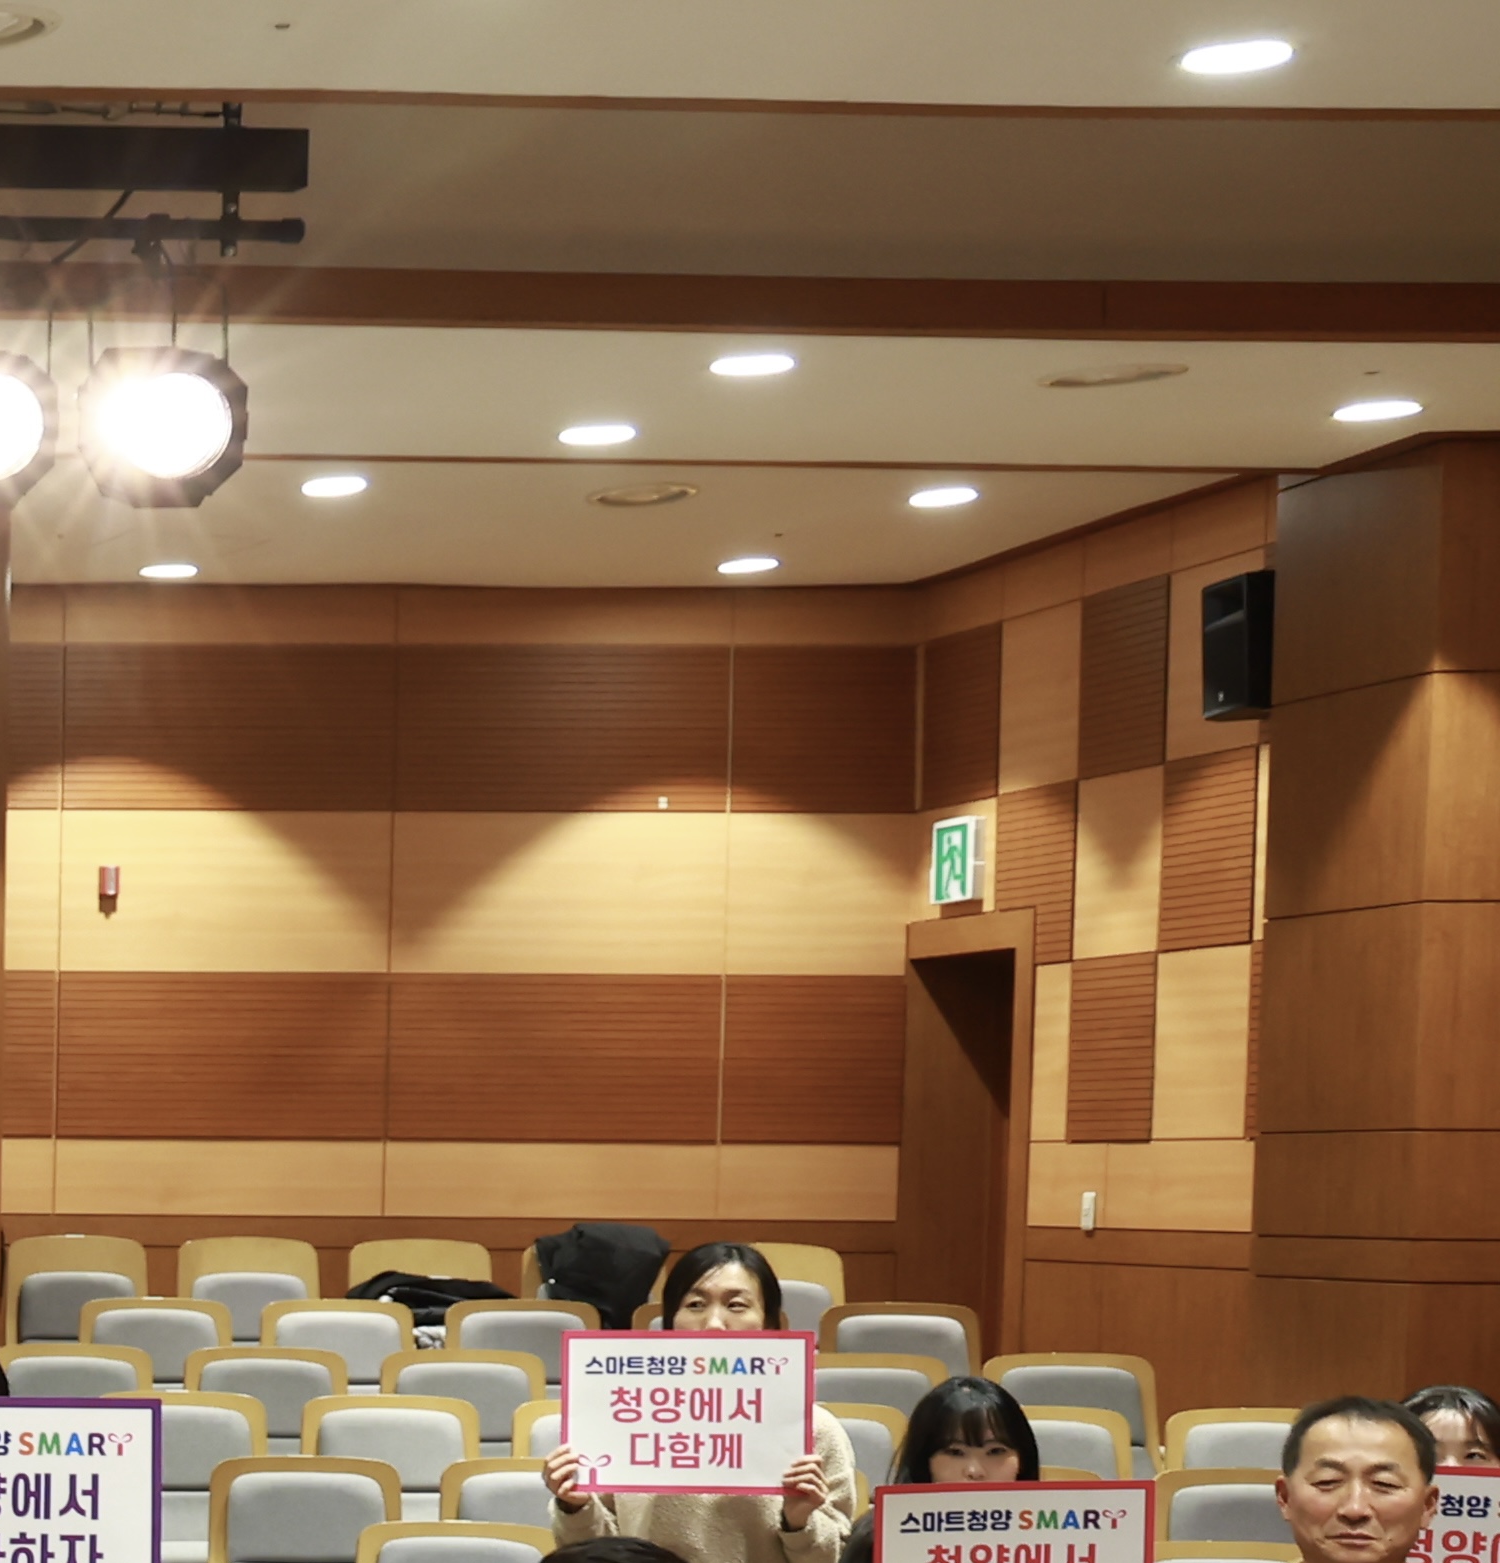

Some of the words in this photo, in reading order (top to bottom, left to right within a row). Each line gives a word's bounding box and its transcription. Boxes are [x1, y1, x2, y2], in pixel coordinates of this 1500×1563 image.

[585, 1356, 687, 1375] 스마트청양
[610, 1387, 762, 1423] 청양에서
[630, 1432, 742, 1469] 다함께
[900, 1510, 1012, 1533] 스마트청양
